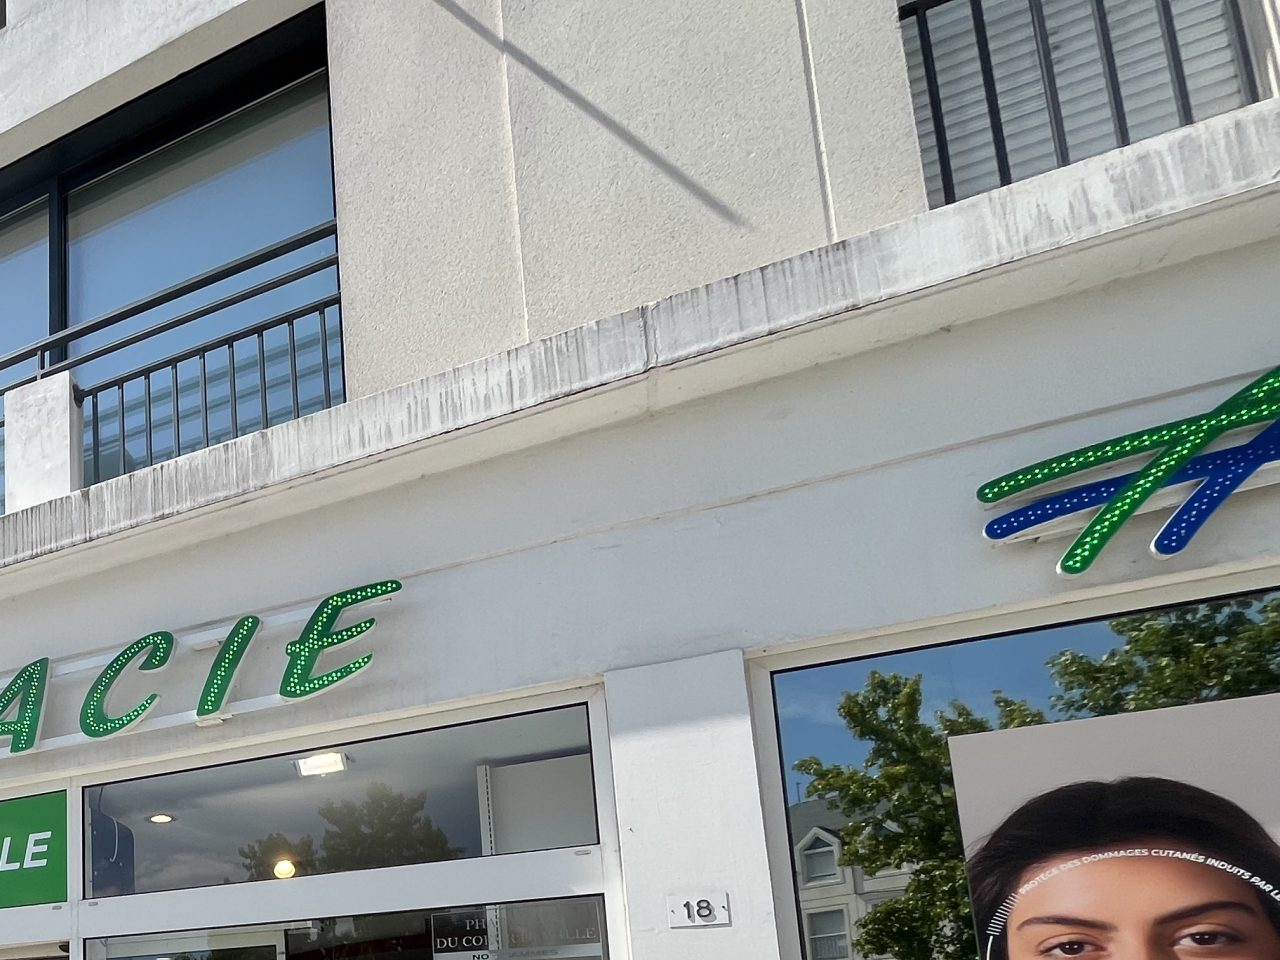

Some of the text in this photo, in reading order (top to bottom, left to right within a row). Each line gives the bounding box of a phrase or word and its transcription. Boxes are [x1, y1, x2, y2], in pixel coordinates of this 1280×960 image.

[1060, 859, 1081, 871] DES
[1082, 848, 1149, 864] DOMMAGES
[1151, 849, 1206, 864] CUTANÉS
[1206, 857, 1251, 879] INDUITS
[1250, 876, 1274, 892] PAR
[683, 899, 712, 919] 18
[436, 937, 458, 949] DU
